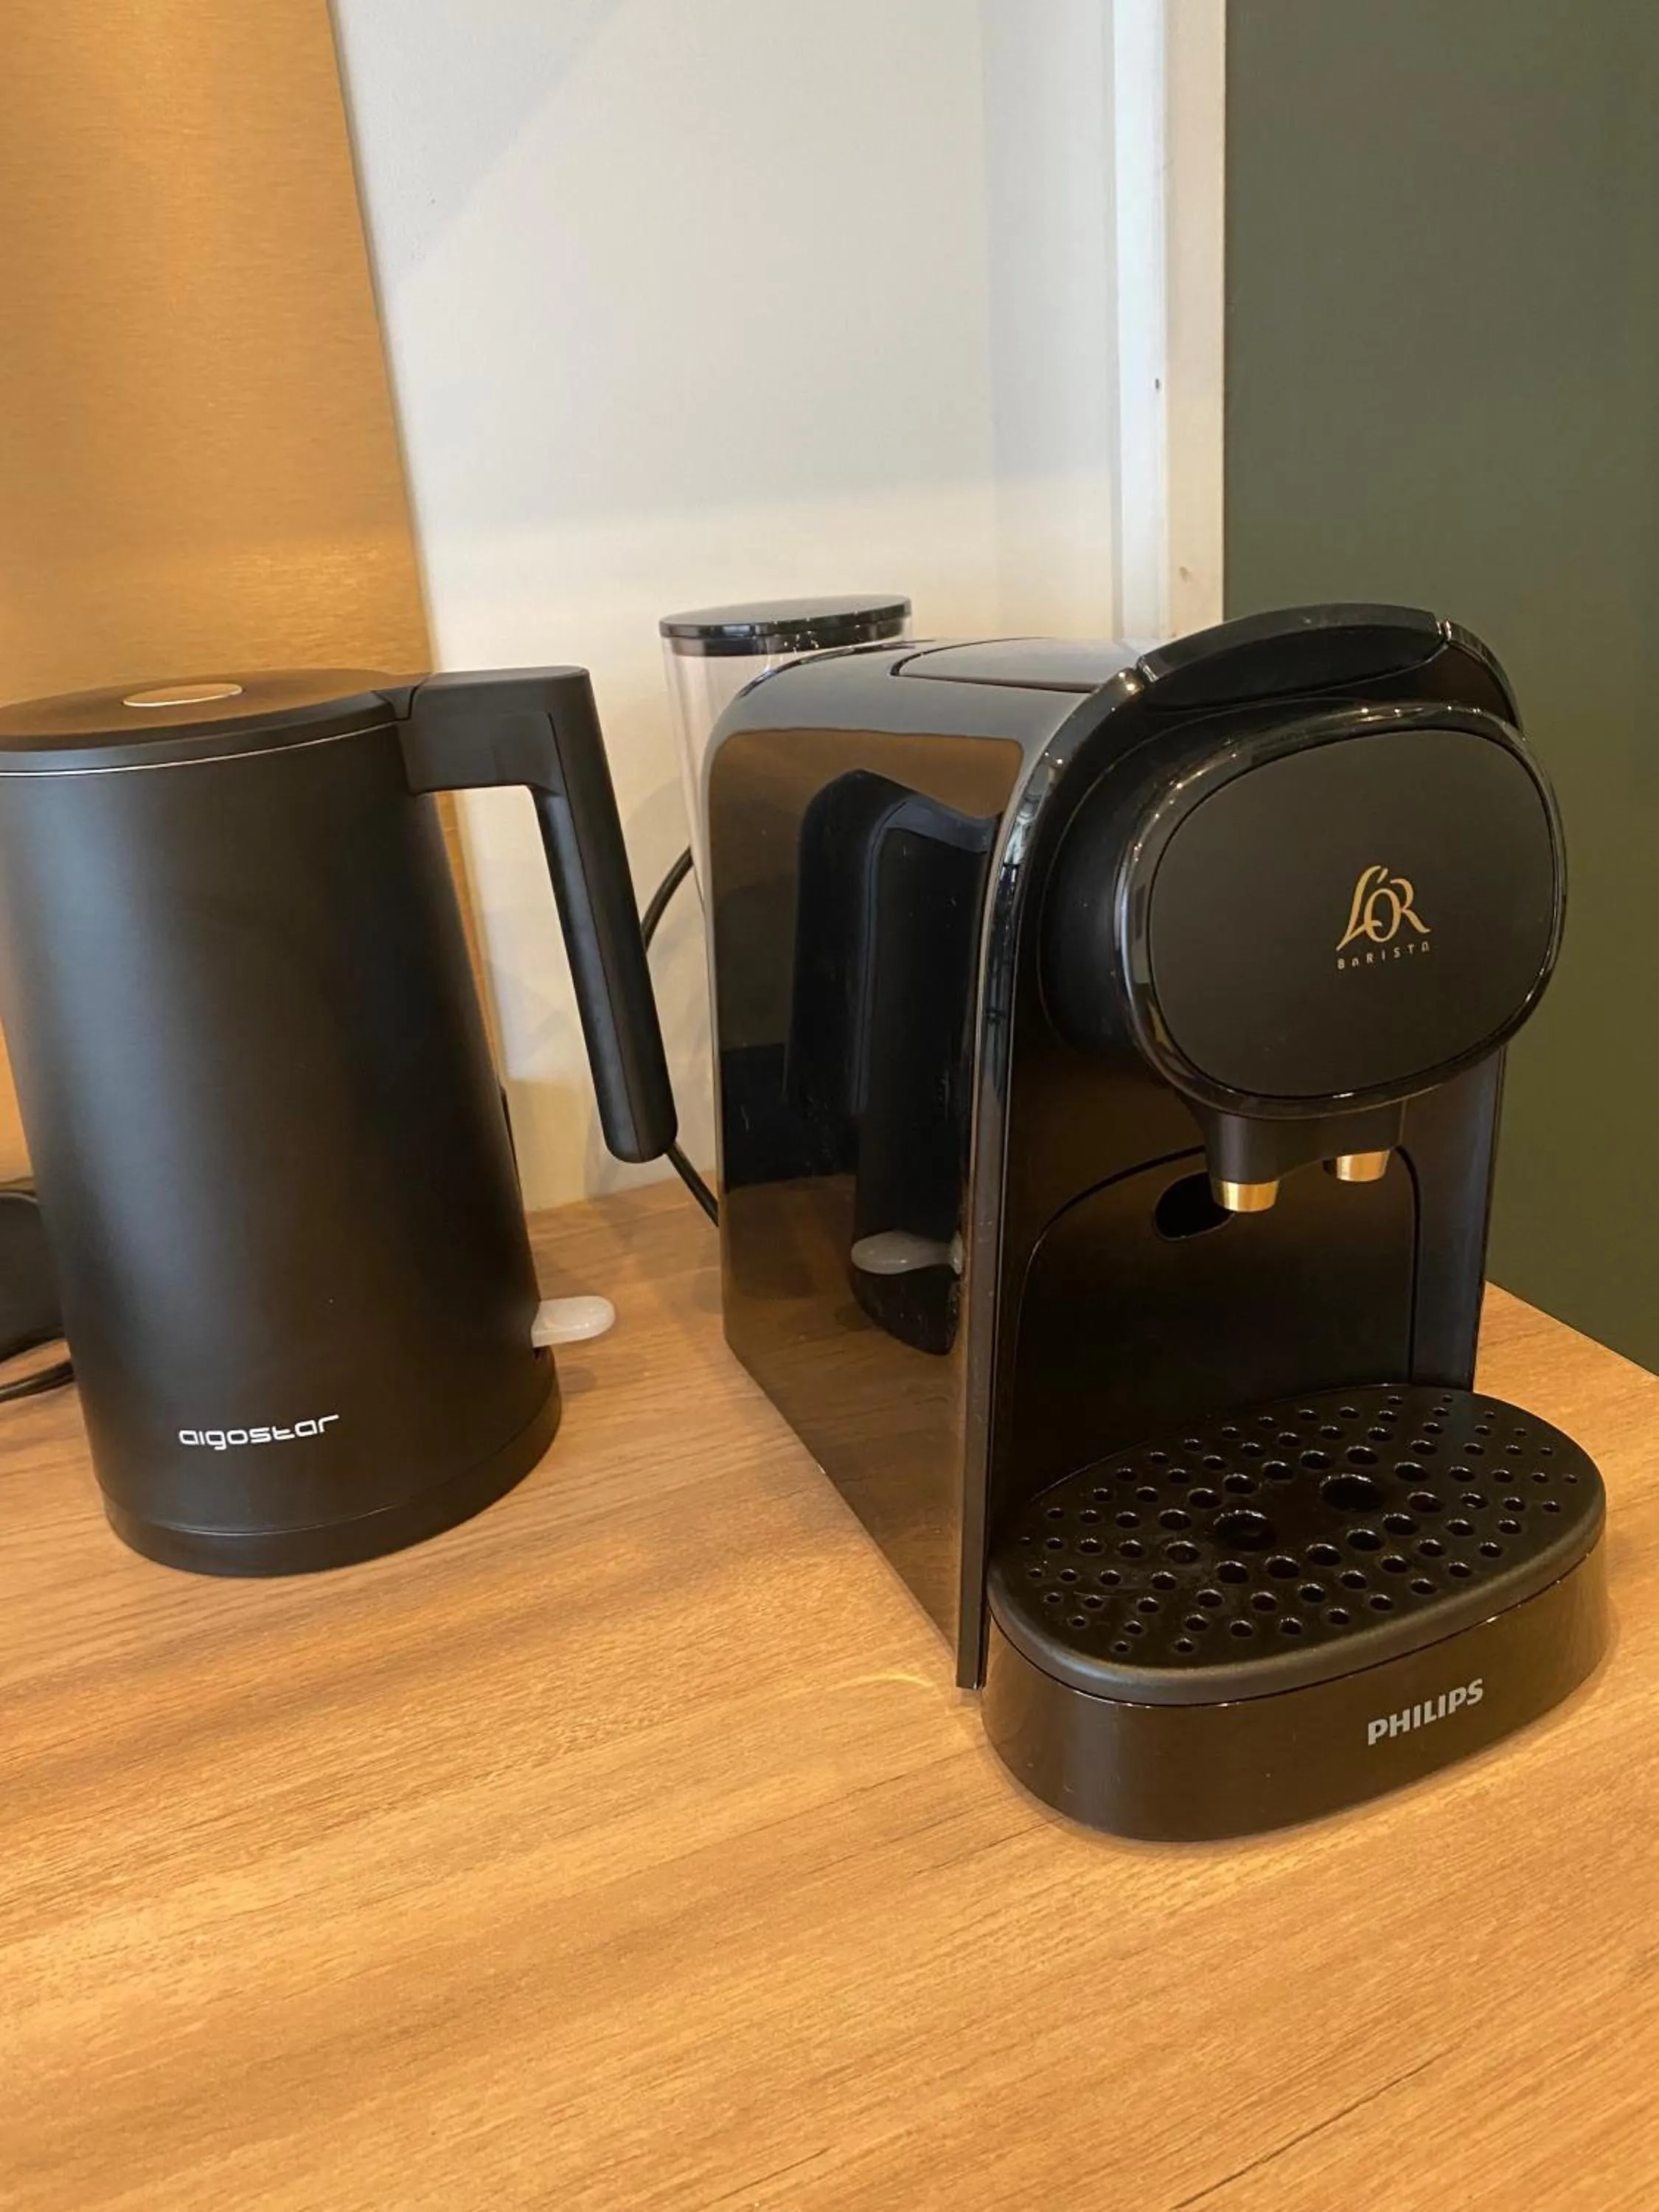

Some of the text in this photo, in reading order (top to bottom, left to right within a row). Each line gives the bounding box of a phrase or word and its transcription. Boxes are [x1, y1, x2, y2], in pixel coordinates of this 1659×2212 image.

[1337, 941, 1430, 970] BARISTA
[178, 1414, 339, 1450] aigostar
[1368, 1678, 1484, 1746] PHILIPS
